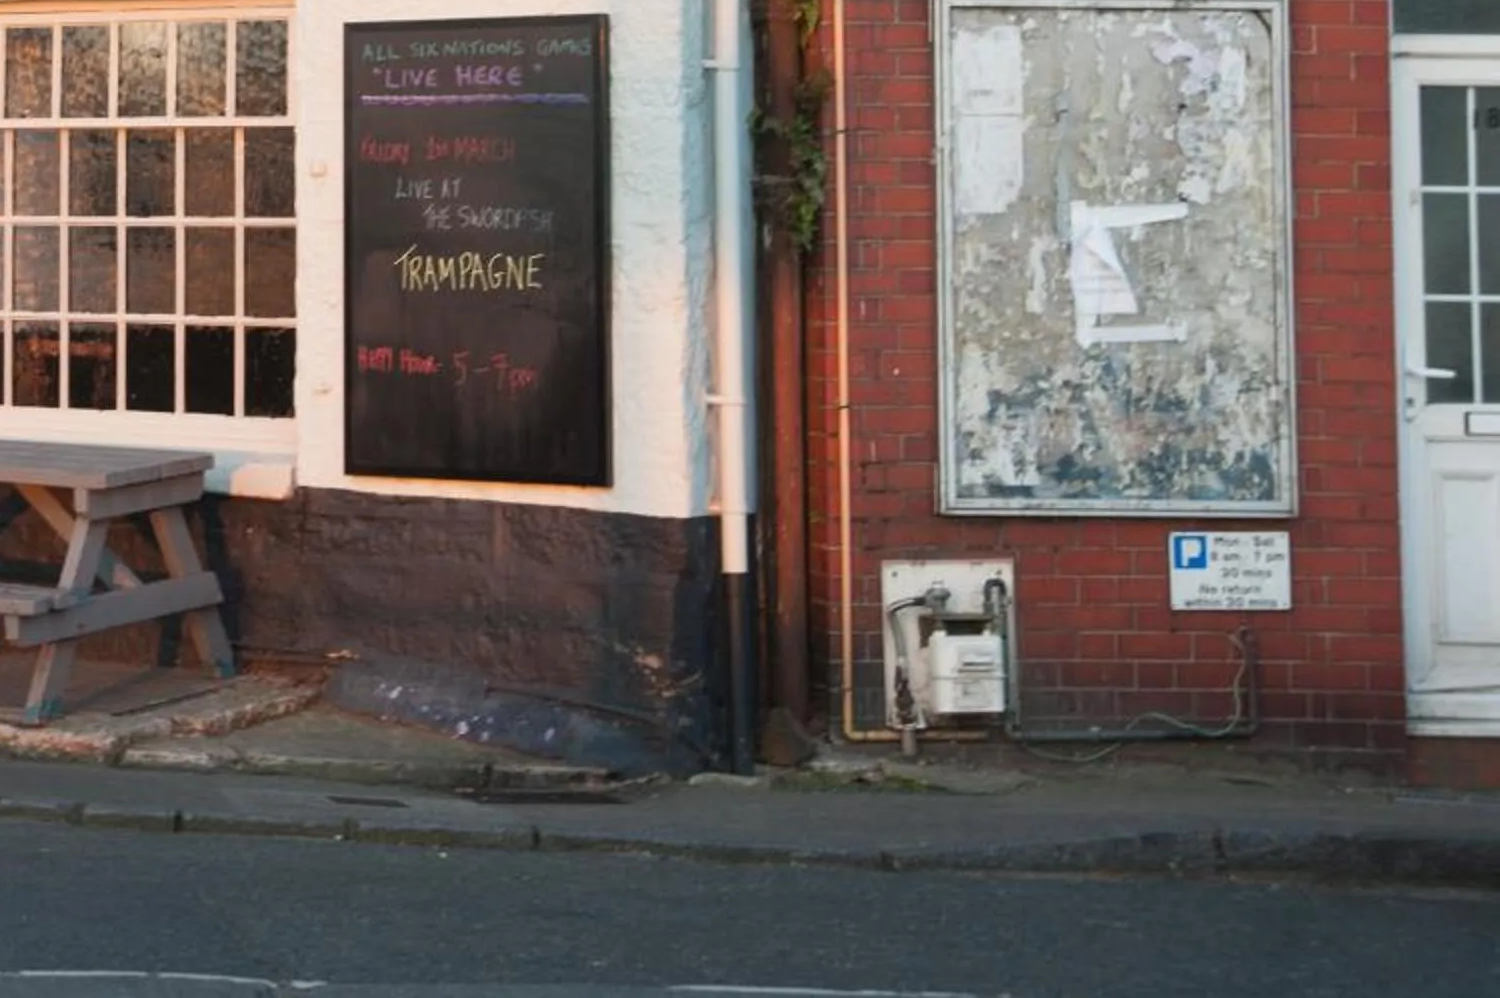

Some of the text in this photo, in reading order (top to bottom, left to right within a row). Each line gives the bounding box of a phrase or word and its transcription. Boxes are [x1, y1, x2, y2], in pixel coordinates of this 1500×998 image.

[361, 42, 400, 63] ALL
[440, 37, 525, 57] NATIONS
[395, 176, 463, 199] LIVE AT
[393, 243, 545, 292] TRAMPAGNE
